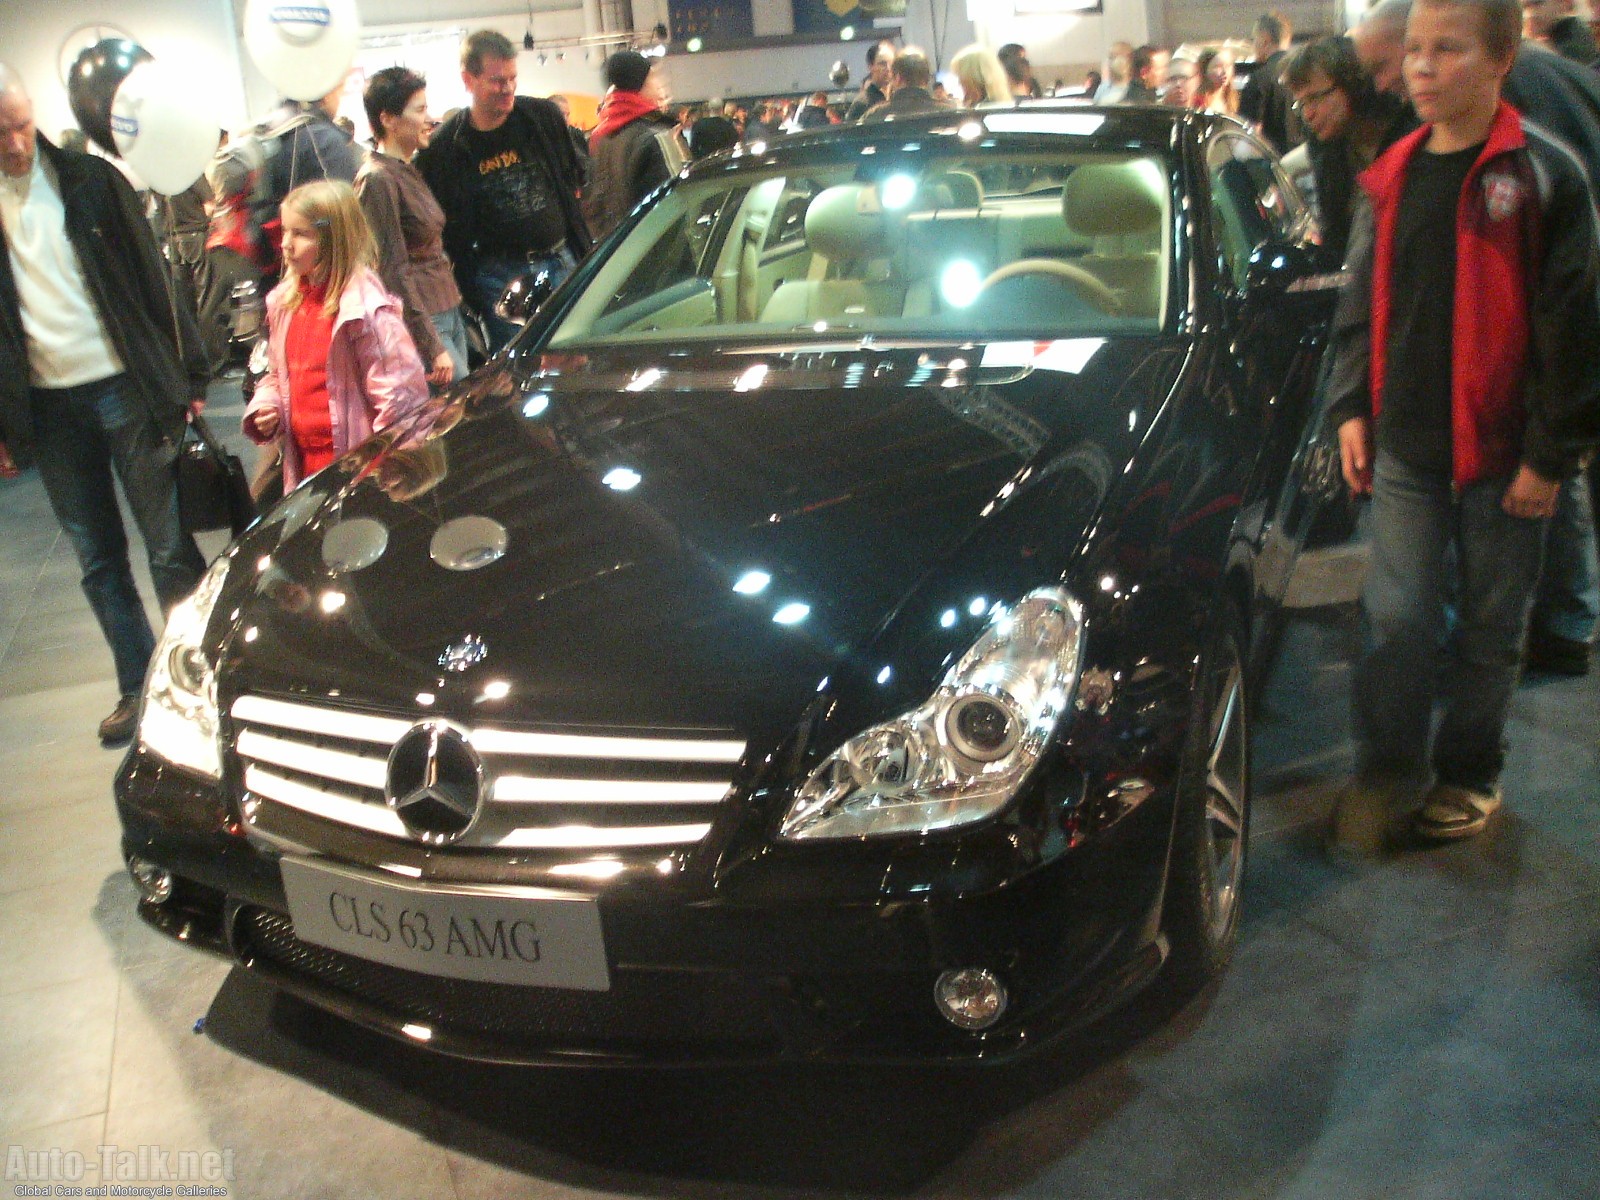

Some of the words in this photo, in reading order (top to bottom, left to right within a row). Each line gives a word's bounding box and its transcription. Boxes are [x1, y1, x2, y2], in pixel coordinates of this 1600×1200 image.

[329, 891, 393, 943] CLS
[398, 909, 435, 952] 63
[446, 915, 542, 963] AMG
